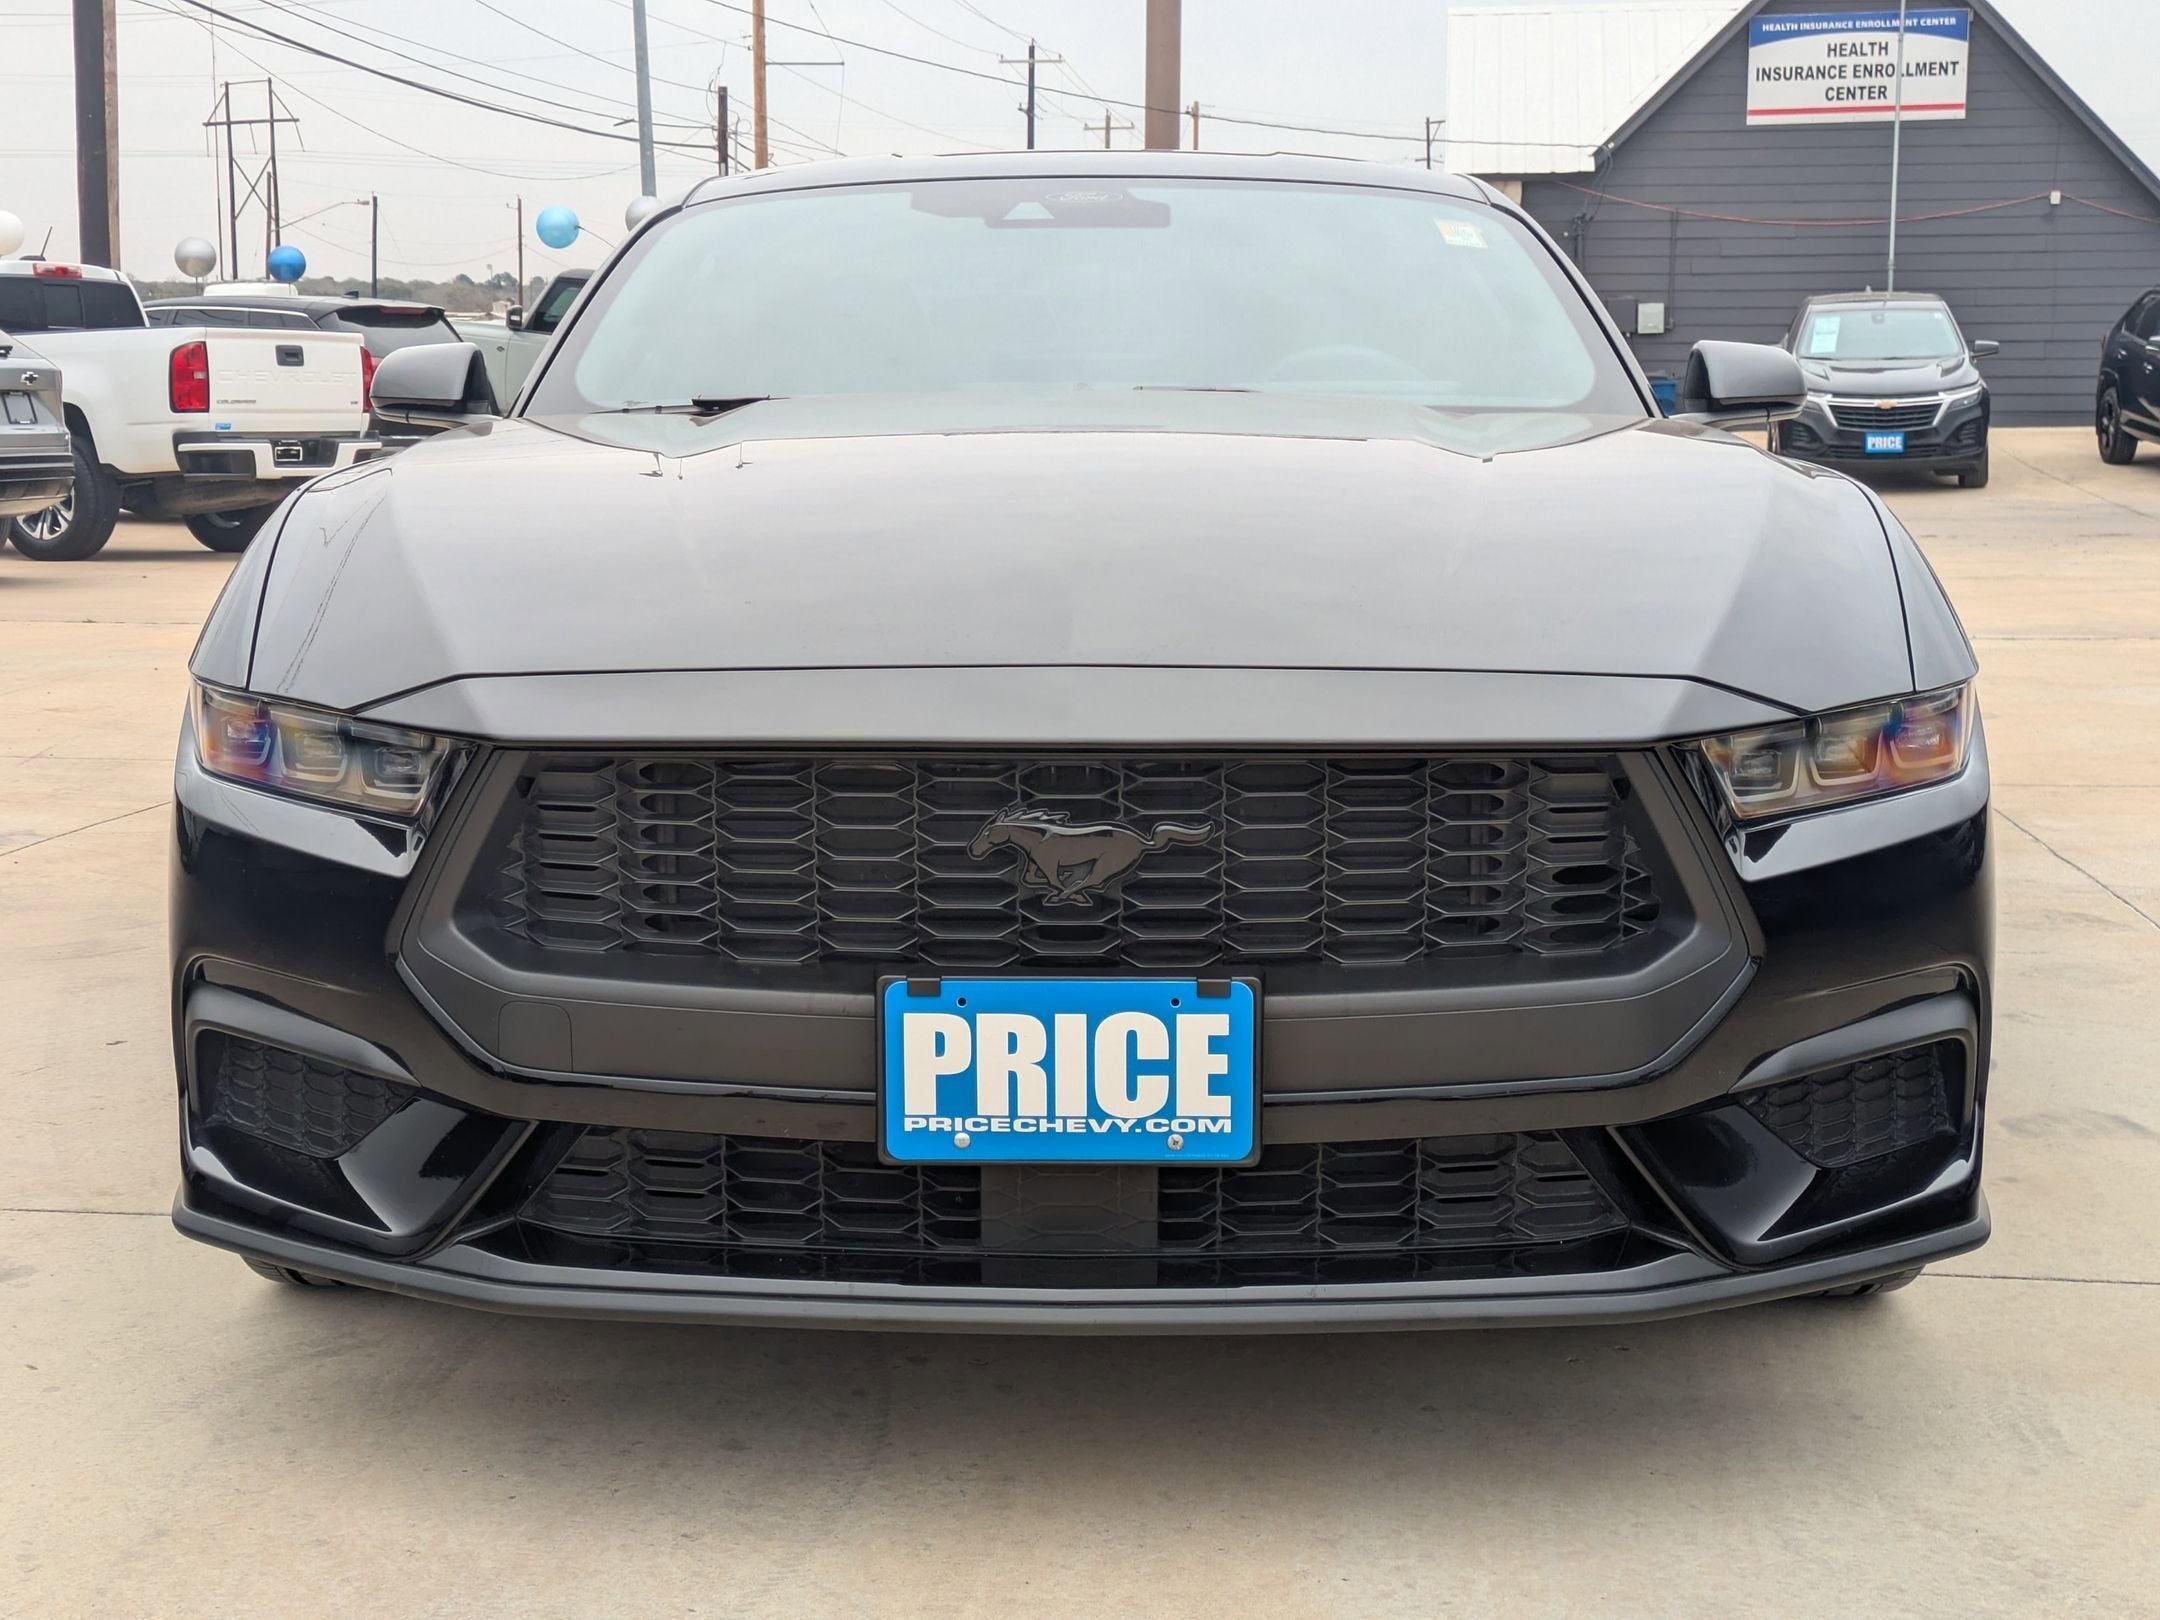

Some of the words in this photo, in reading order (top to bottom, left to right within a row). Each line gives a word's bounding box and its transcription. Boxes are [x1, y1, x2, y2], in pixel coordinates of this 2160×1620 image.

[1762, 23, 1798, 32] HEALTH
[1800, 20, 1853, 30] INSURANCE
[1855, 18, 1917, 28] ENROLLMNT
[1920, 17, 1956, 27] CENTER
[1827, 41, 1889, 58] HEALTH
[1756, 65, 1847, 82] INSURANCE
[1853, 61, 1959, 79] ENROLMENT
[1825, 85, 1888, 102] CENTER
[1867, 436, 1903, 449] PRICE
[903, 1012, 1232, 1118] PRICE
[904, 1117, 1232, 1133] PRICECHEVY.COM
